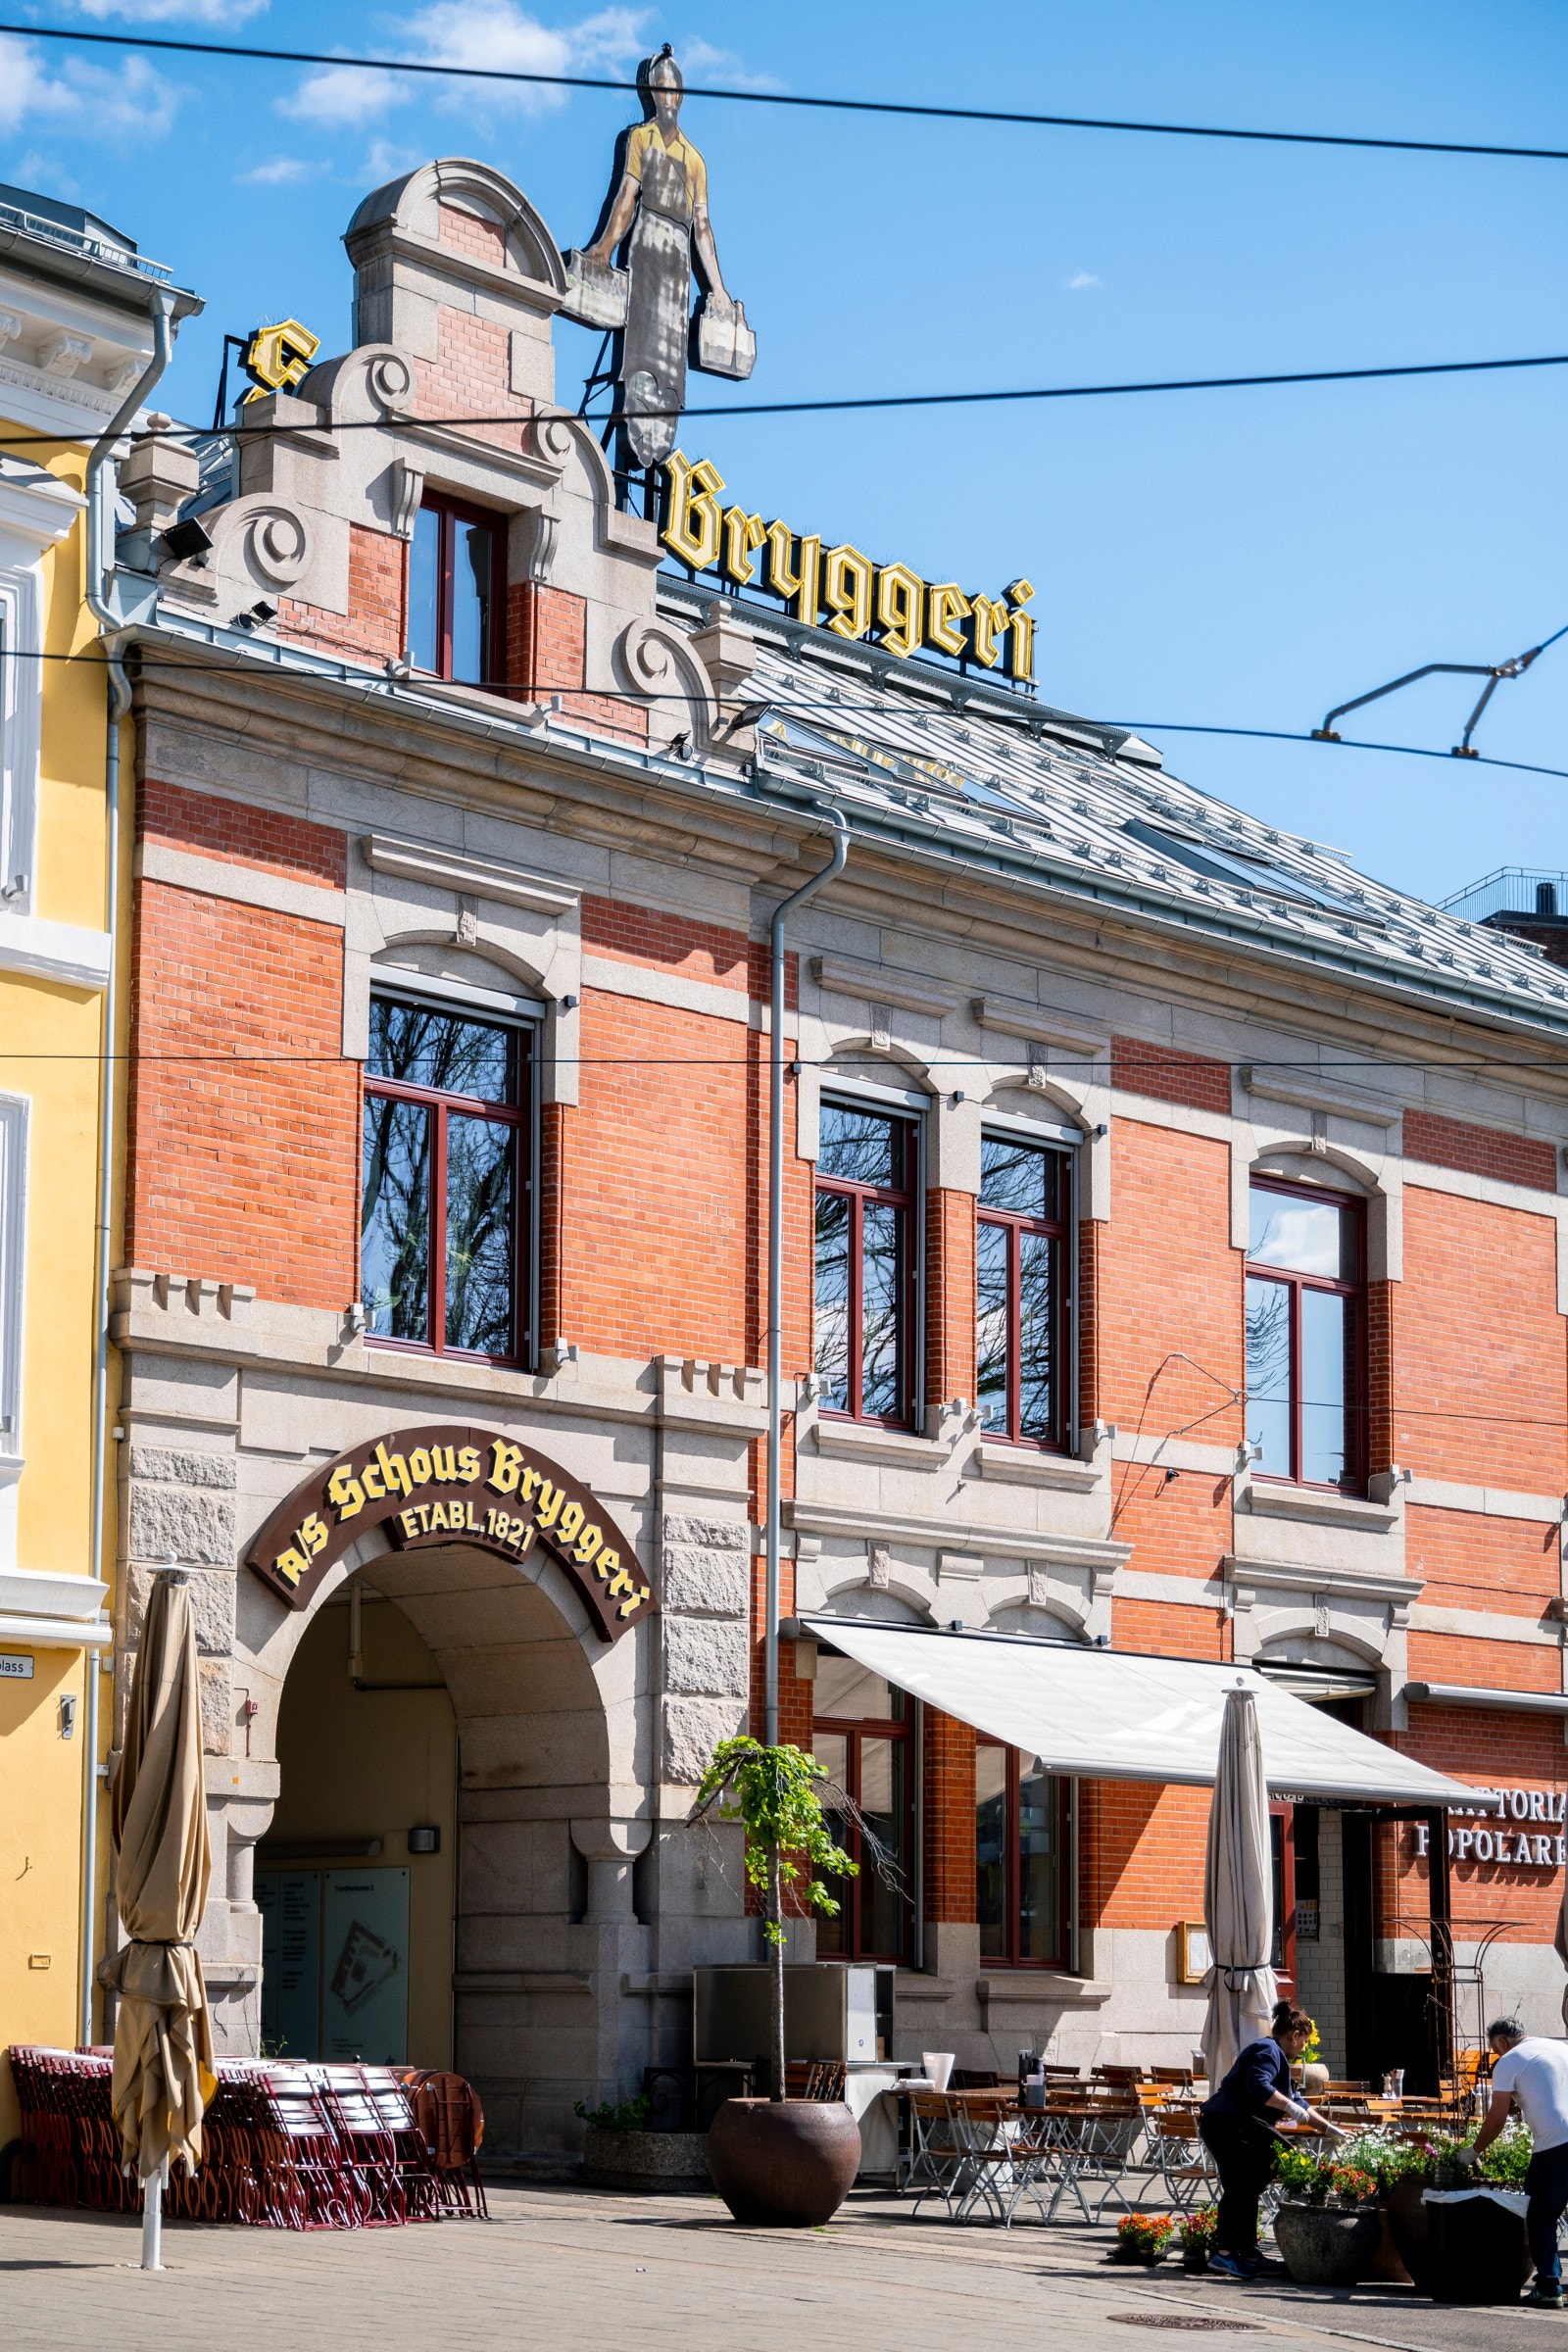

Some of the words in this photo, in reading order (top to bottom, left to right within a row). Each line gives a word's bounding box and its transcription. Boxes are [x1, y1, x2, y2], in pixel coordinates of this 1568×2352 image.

[661, 448, 1036, 680] Bryggeri
[276, 1511, 329, 1587] A/S
[327, 1441, 481, 1521] Schous
[487, 1438, 651, 1618] Bryggeri
[0, 1659, 24, 1672] lass
[1416, 1826, 1567, 1866] PPOLARE
